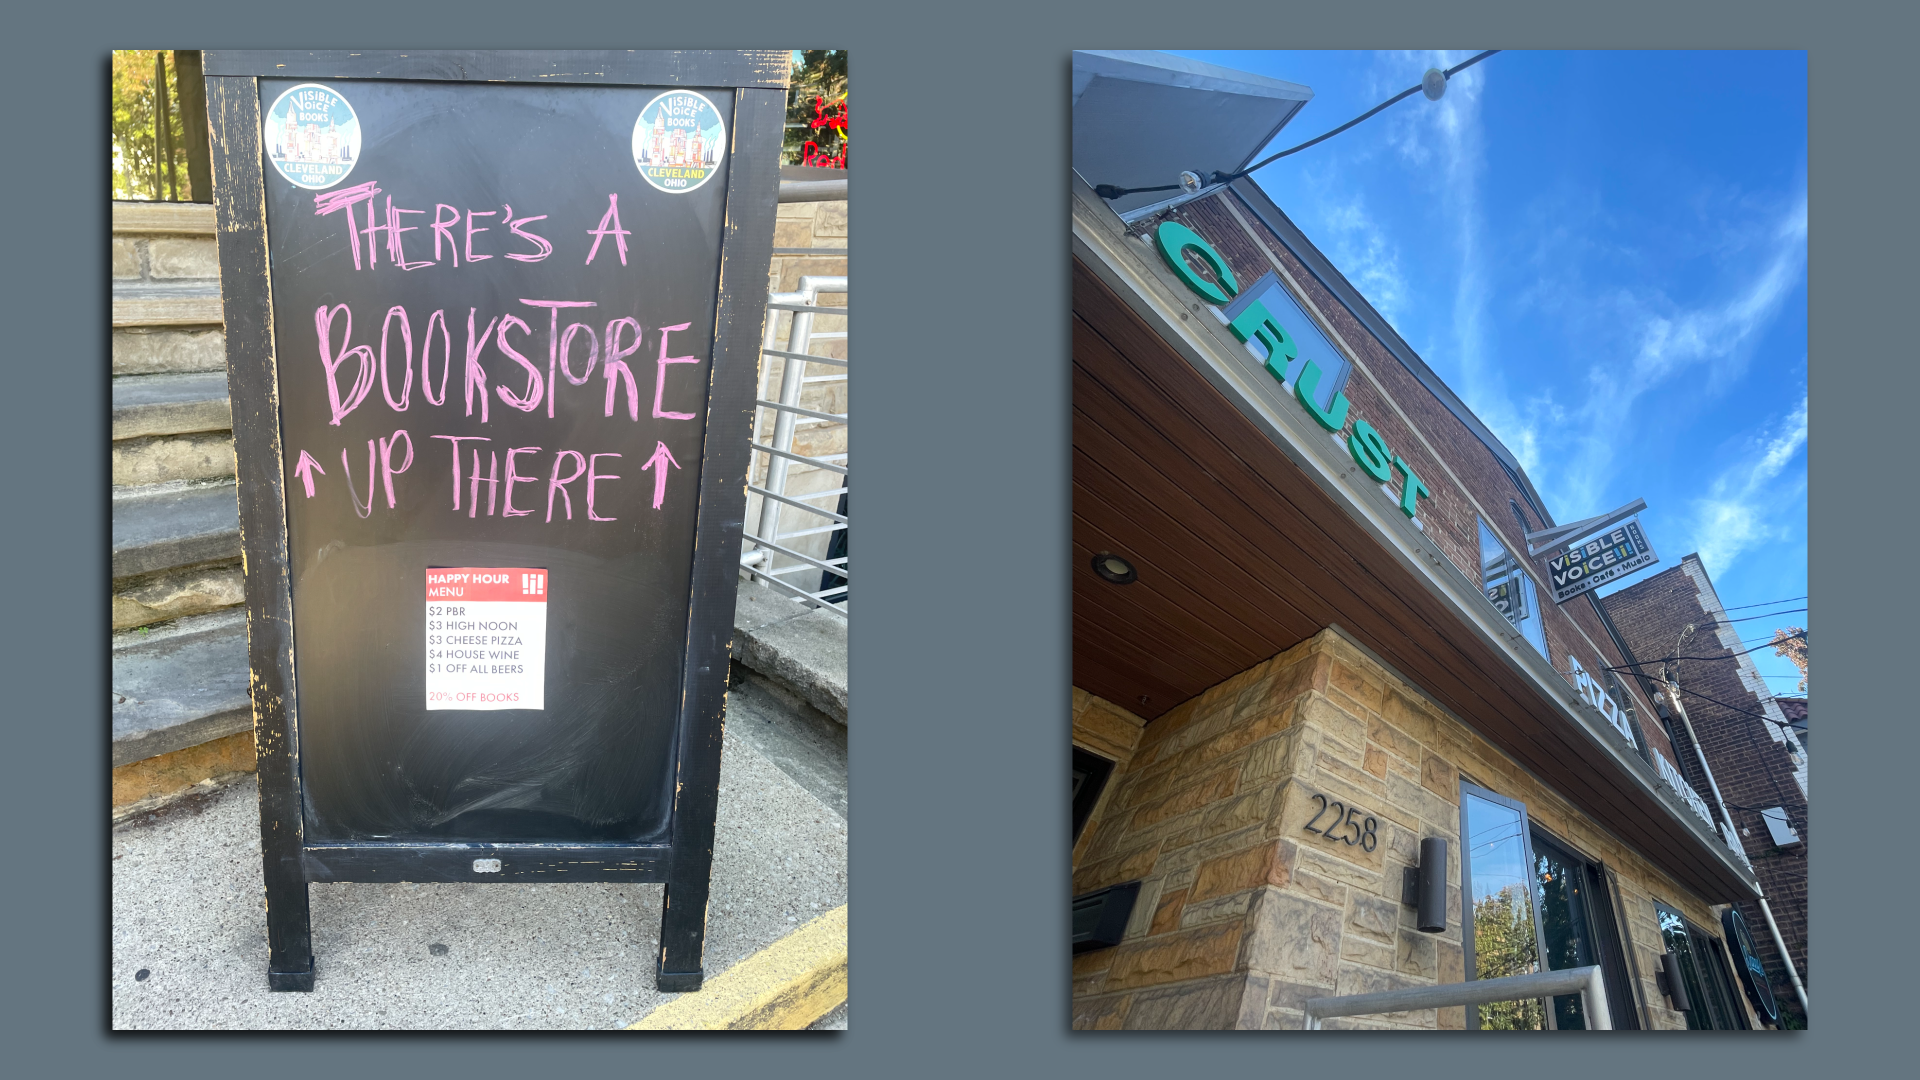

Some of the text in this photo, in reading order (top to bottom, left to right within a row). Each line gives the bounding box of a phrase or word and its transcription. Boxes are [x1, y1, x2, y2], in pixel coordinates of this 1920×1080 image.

[300, 113, 328, 122] BOOKS
[667, 118, 695, 127] BOOKS
[284, 163, 343, 175] CLEVELAND
[648, 168, 705, 179] CLEVELAND
[301, 174, 326, 183] OHIO
[664, 179, 687, 187] OHIO
[314, 181, 632, 271] THERE'S A
[315, 299, 701, 426] BOOKSTORE
[1154, 221, 1430, 519] CRUST
[341, 430, 623, 523] UP THERE
[428, 574, 510, 584] HAPPY HOUR
[1558, 583, 1586, 599] Books
[1592, 570, 1615, 583] Café
[428, 587, 464, 597] MENU
[429, 606, 466, 617] $2 PBR
[429, 620, 518, 631] $3 HIGH NOON
[429, 634, 523, 646] $3 CHEESE PIZZA
[429, 649, 520, 660] $4 HOUSE WINE
[429, 663, 524, 674] $1 OFF ALL BEERS
[429, 691, 519, 703] 20% OFF BOOKS
[1567, 654, 1639, 751] PIZZA
[1303, 793, 1378, 853] 2258
